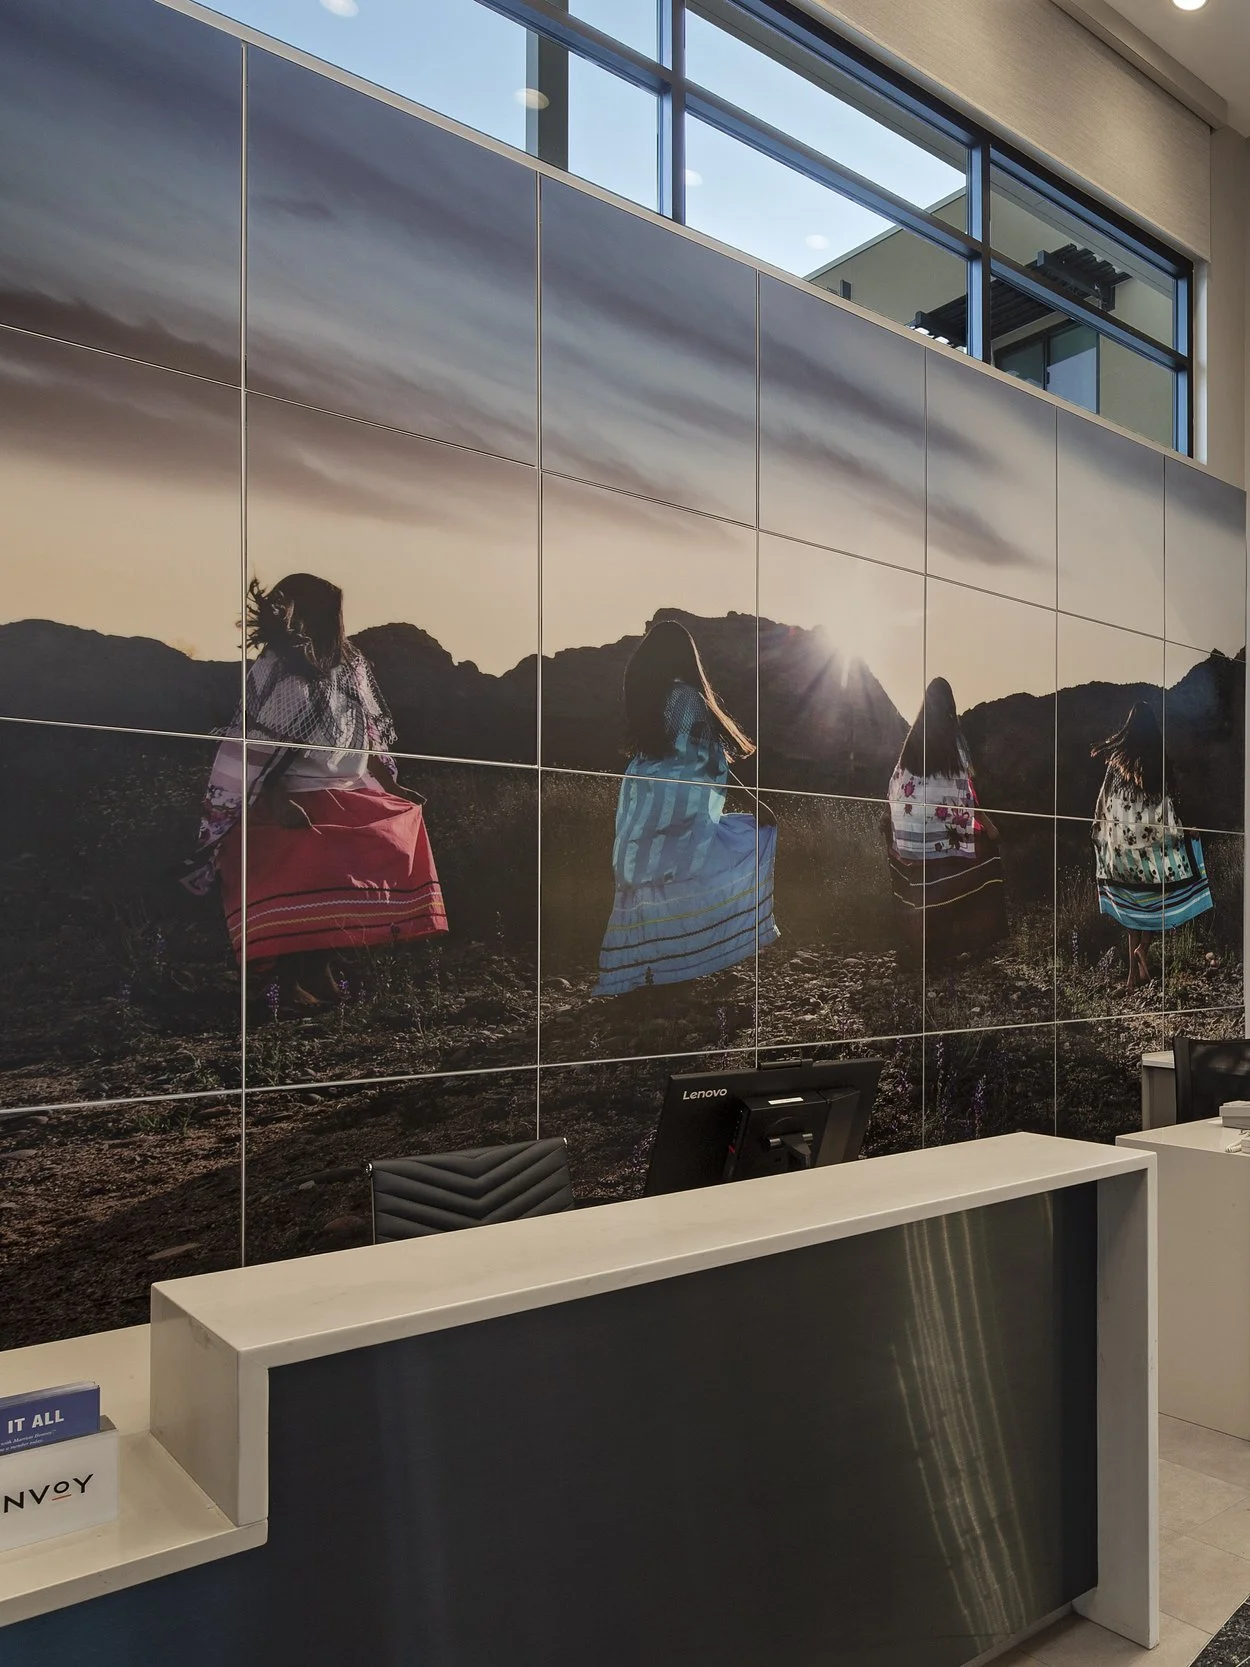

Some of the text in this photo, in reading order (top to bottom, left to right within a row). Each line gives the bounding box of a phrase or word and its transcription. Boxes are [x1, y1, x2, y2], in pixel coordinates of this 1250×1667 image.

[682, 1088, 728, 1100] Lenovo
[8, 1409, 65, 1434] IT ALL
